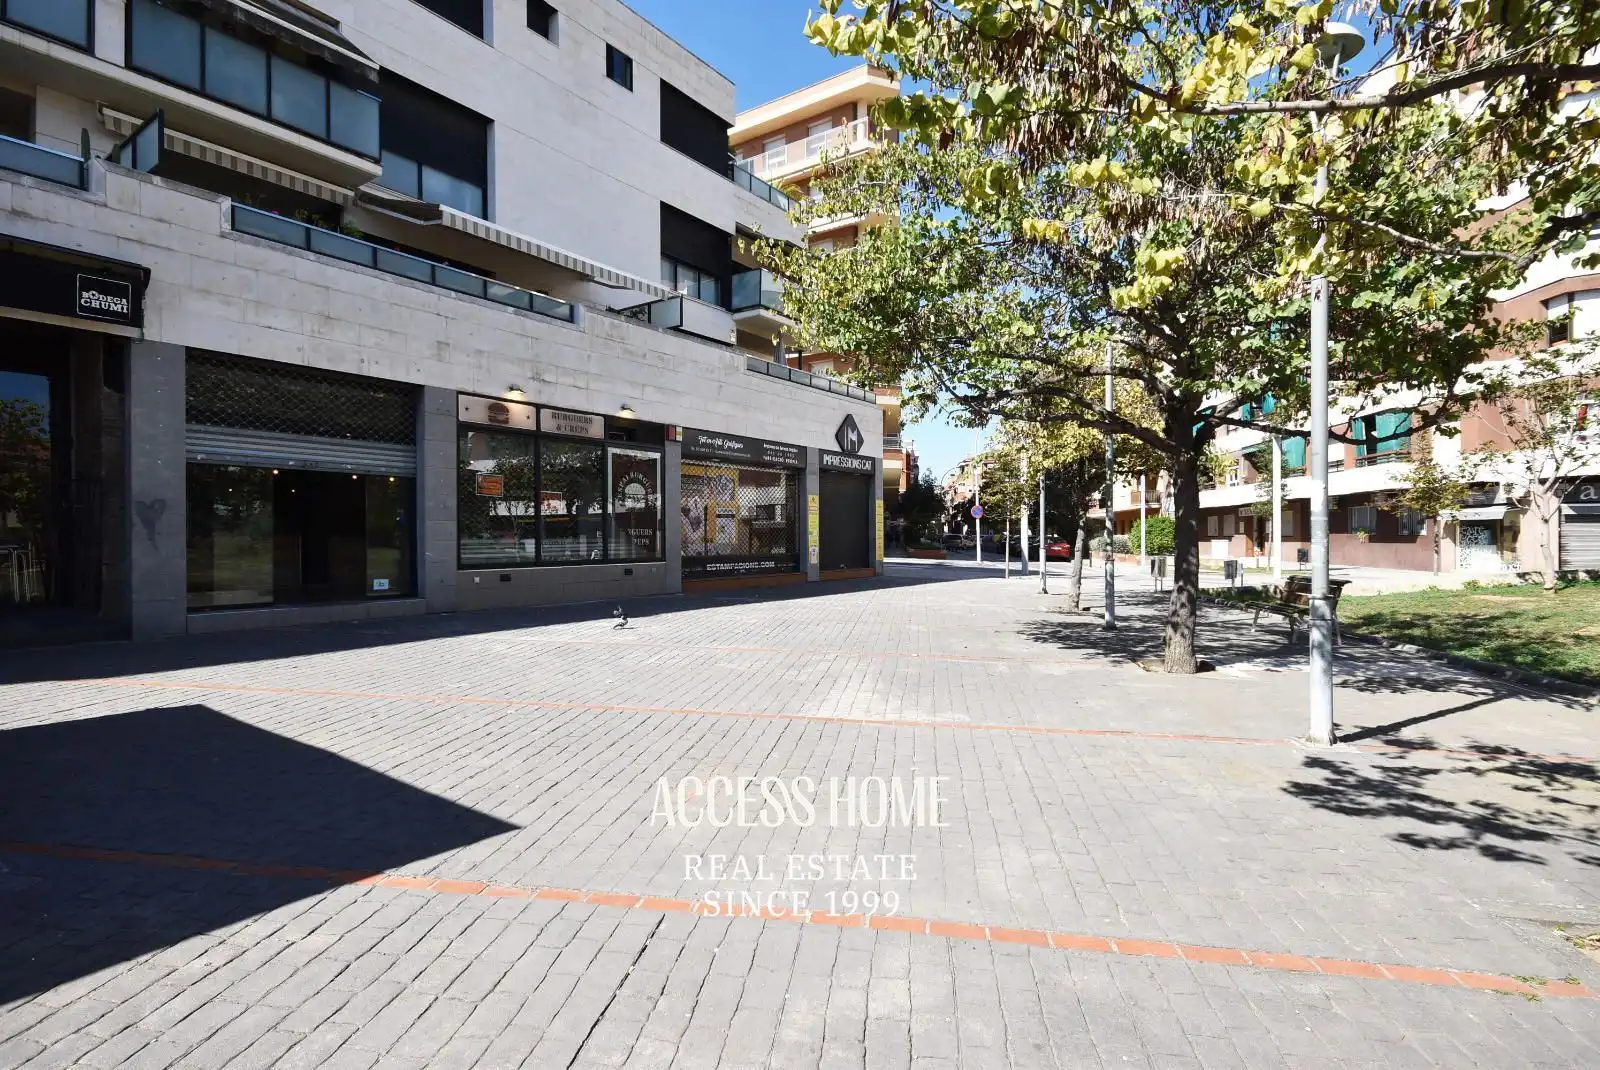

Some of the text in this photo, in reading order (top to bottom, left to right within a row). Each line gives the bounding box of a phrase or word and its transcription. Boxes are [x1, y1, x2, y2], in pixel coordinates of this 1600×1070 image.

[82, 290, 128, 305] BODEGA
[81, 298, 128, 313] CHUMI
[823, 453, 862, 469] IMPRESSIONS
